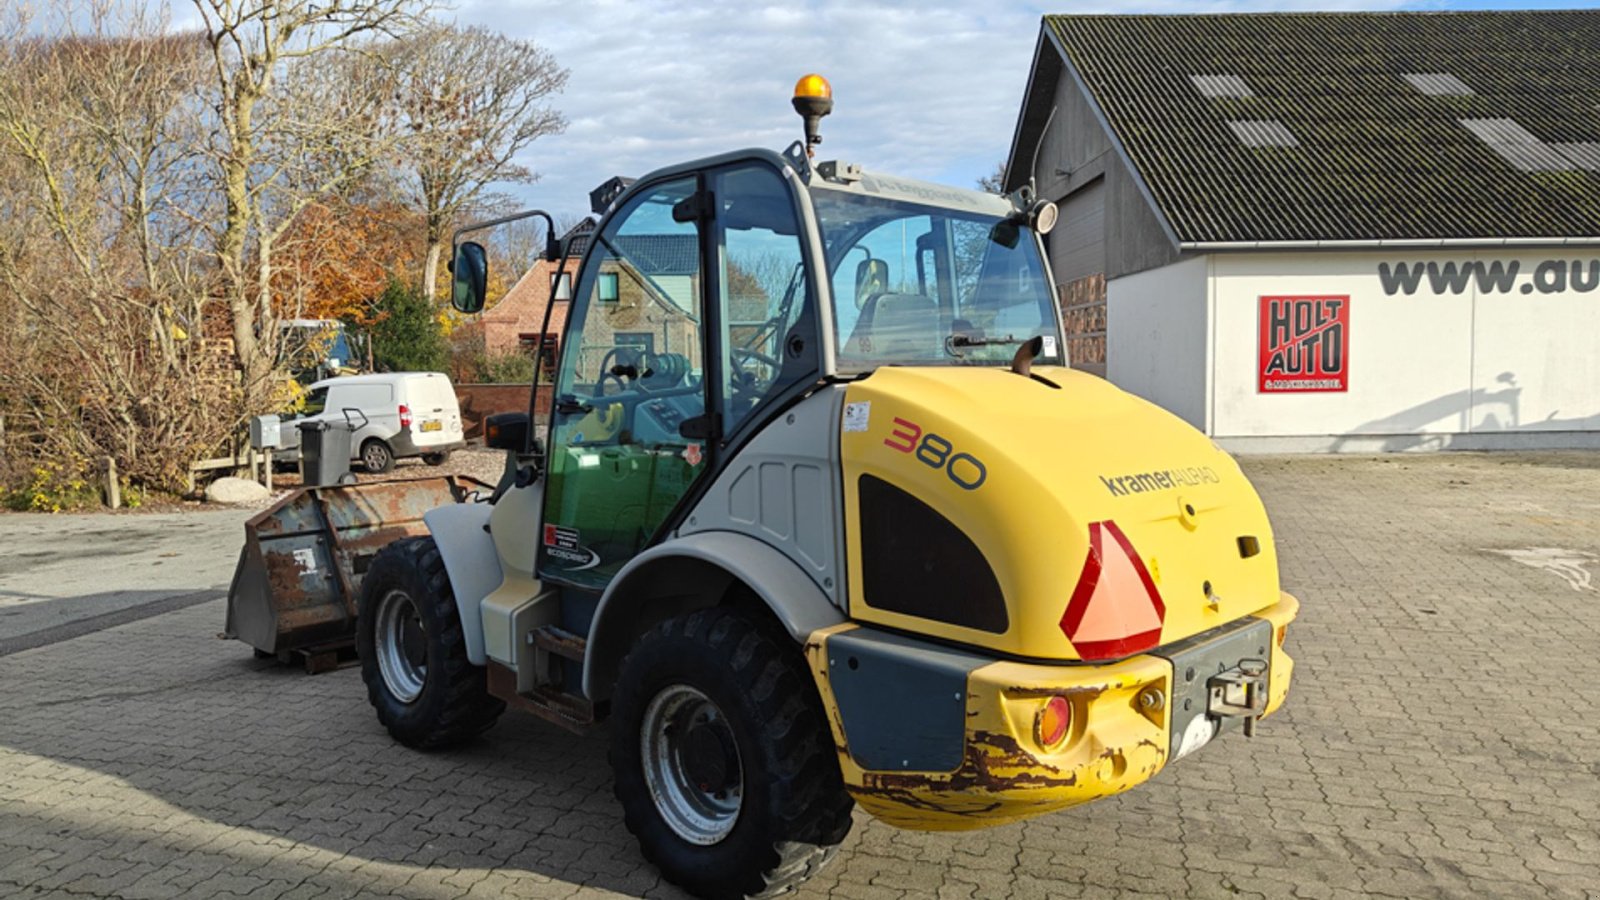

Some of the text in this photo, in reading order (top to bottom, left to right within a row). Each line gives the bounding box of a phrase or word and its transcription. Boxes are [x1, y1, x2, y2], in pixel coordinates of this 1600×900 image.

[1266, 323, 1342, 374] AUTO
[1270, 300, 1342, 350] HOLT
[884, 417, 987, 490] 380
